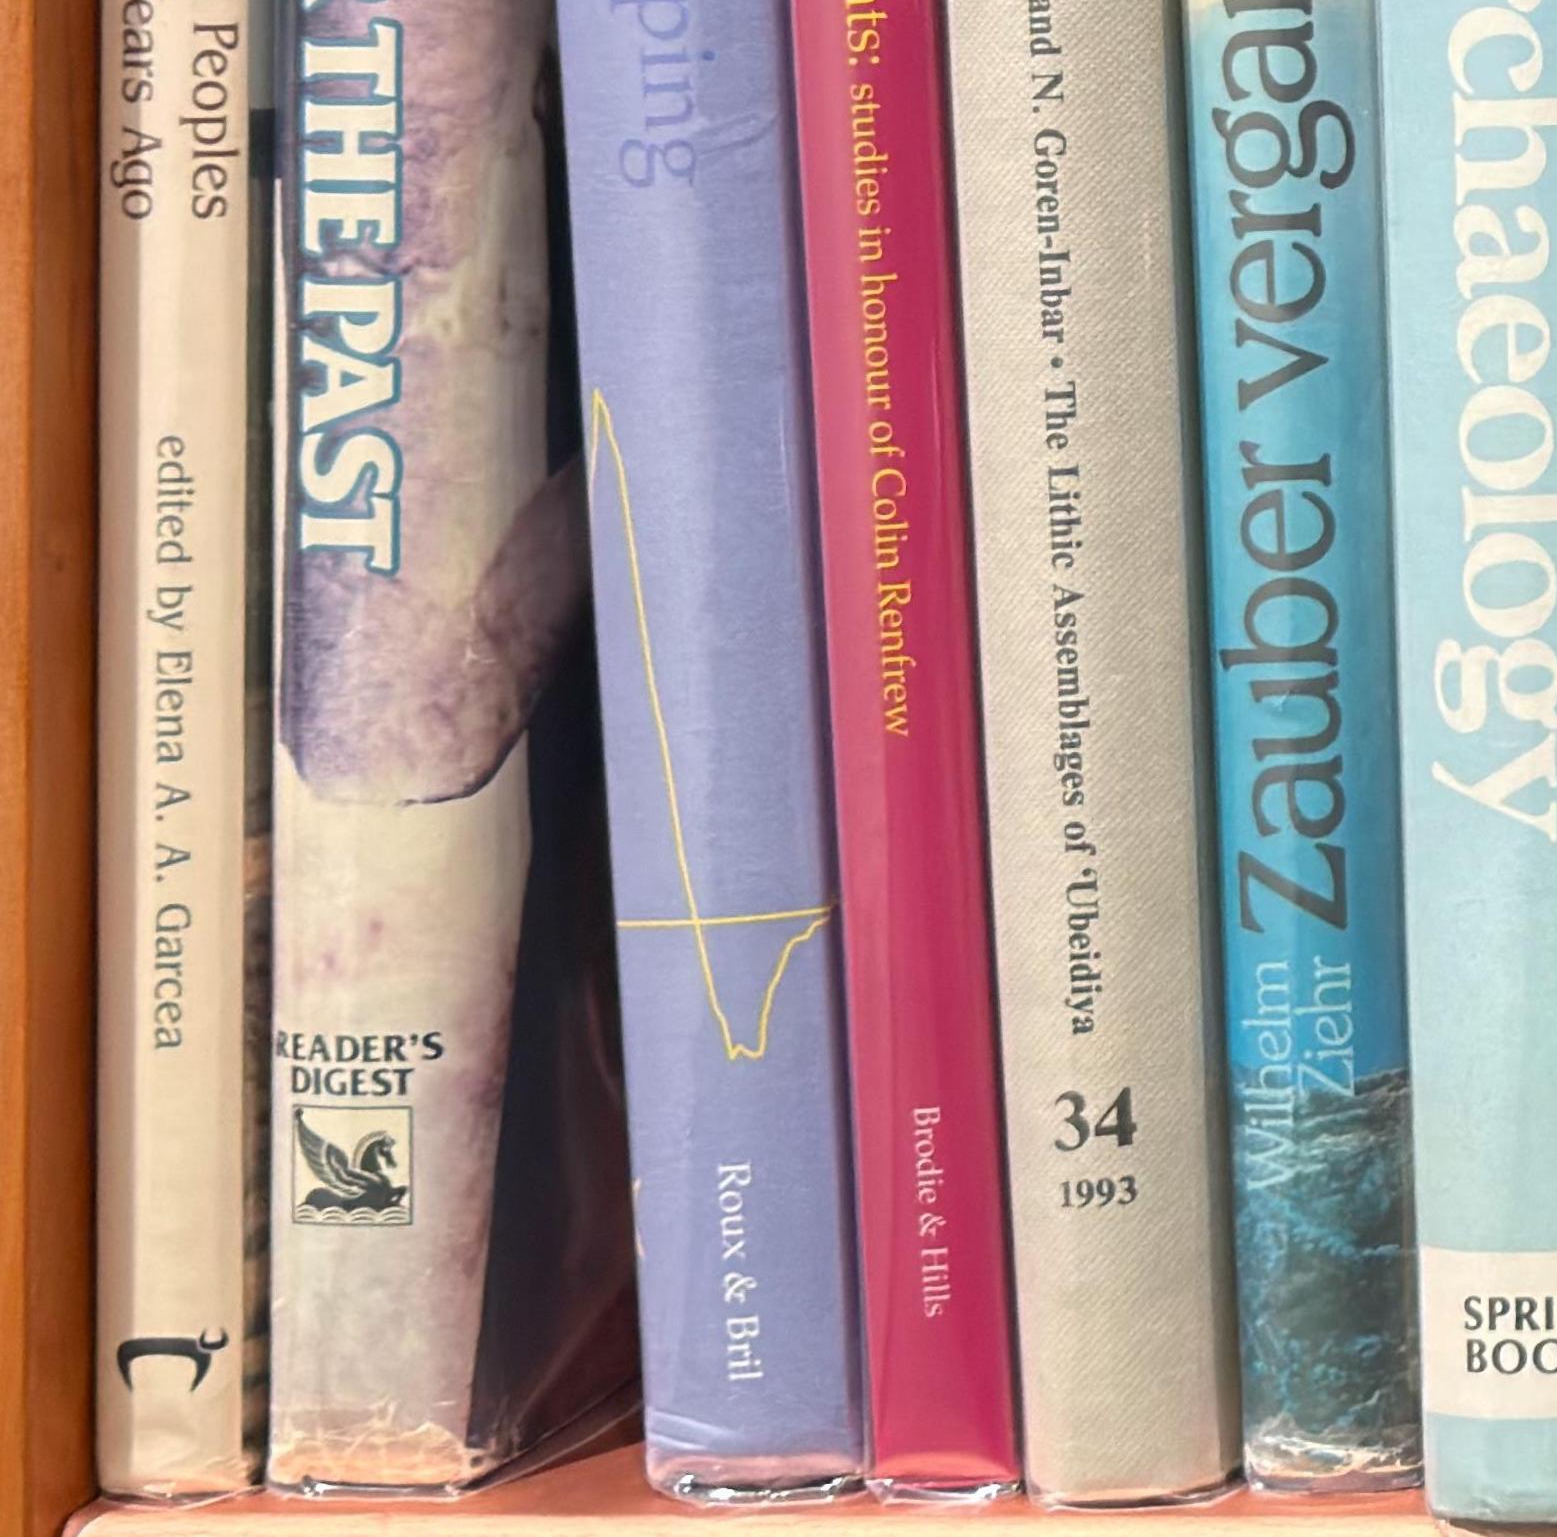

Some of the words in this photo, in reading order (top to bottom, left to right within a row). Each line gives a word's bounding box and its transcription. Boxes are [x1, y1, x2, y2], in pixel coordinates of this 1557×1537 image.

[179, 20, 238, 221] Peoples
[298, 21, 406, 257] THE
[1029, 71, 1066, 115] N.
[110, 125, 163, 221] Ago
[848, 81, 891, 214] studies
[856, 224, 893, 261] in
[1032, 127, 1071, 342] Goren-Inbar
[859, 270, 899, 410] honour
[297, 274, 405, 579] PAST
[865, 420, 904, 456] of
[1043, 380, 1079, 451] The
[870, 466, 909, 569] Colin
[1048, 464, 1087, 571] Lithic
[875, 578, 915, 736] Renfrew
[1049, 582, 1092, 807] Assemblages
[1219, 440, 1351, 932] Zauber
[1062, 821, 1096, 855] of
[275, 1031, 444, 1064] READER'S
[292, 1065, 414, 1097] DIGEST
[1054, 1087, 1138, 1153] 34
[1058, 1174, 1138, 1209] 1993
